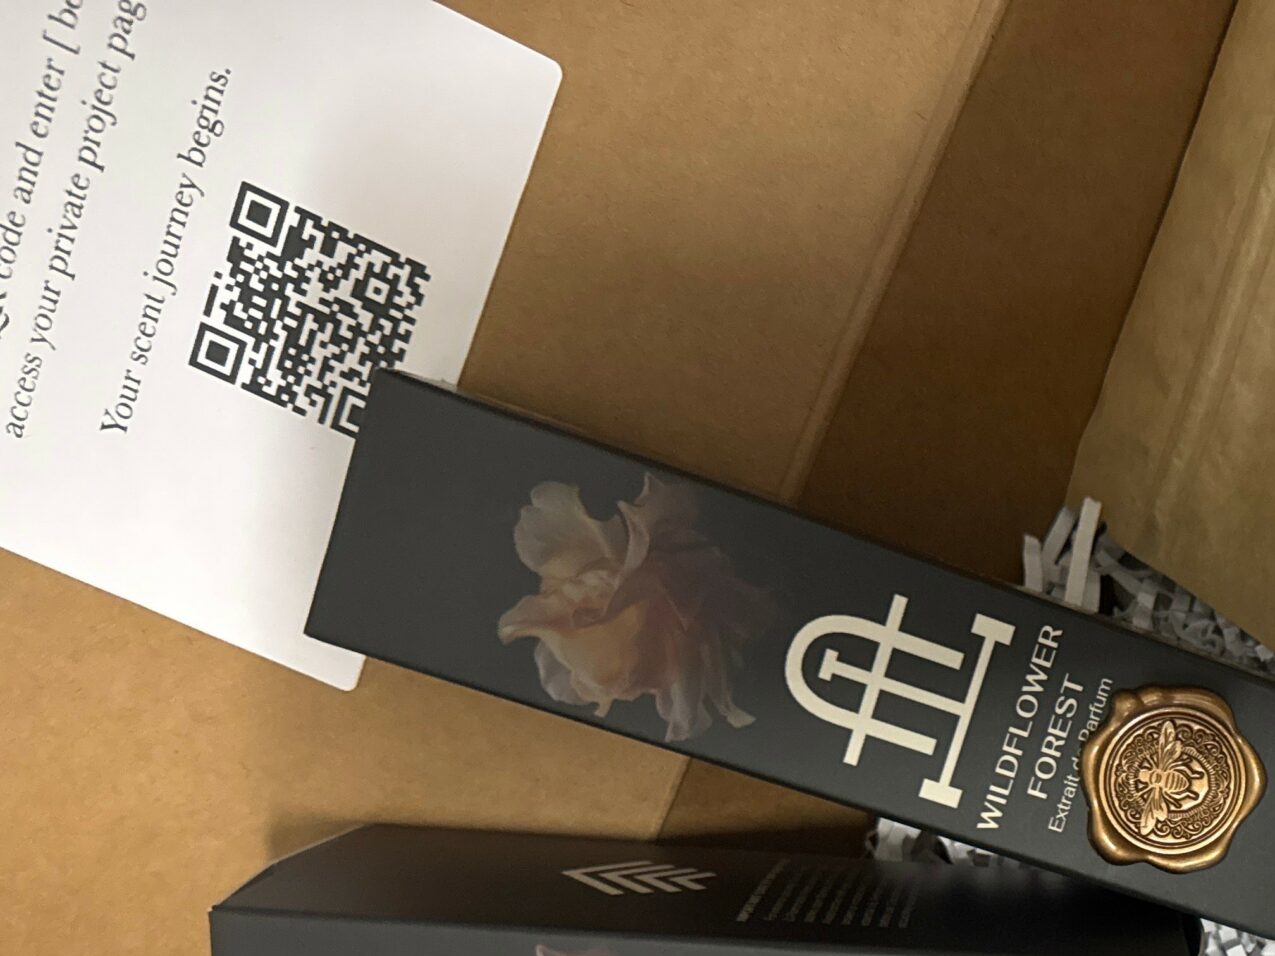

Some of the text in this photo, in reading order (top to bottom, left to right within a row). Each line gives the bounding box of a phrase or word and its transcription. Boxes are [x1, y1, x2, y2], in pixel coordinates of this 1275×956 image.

[14, 142, 44, 205] and
[30, 57, 65, 138] enter
[6, 352, 43, 438] access
[30, 279, 62, 350] your
[47, 173, 91, 281] private
[78, 60, 121, 173] project
[100, 68, 232, 435] Your scent journey begins.
[976, 624, 1064, 830] WILDFLOWER
[1027, 672, 1085, 800] FOREST
[1048, 774, 1081, 833] Extrait
[1078, 677, 1114, 742] Parfum
